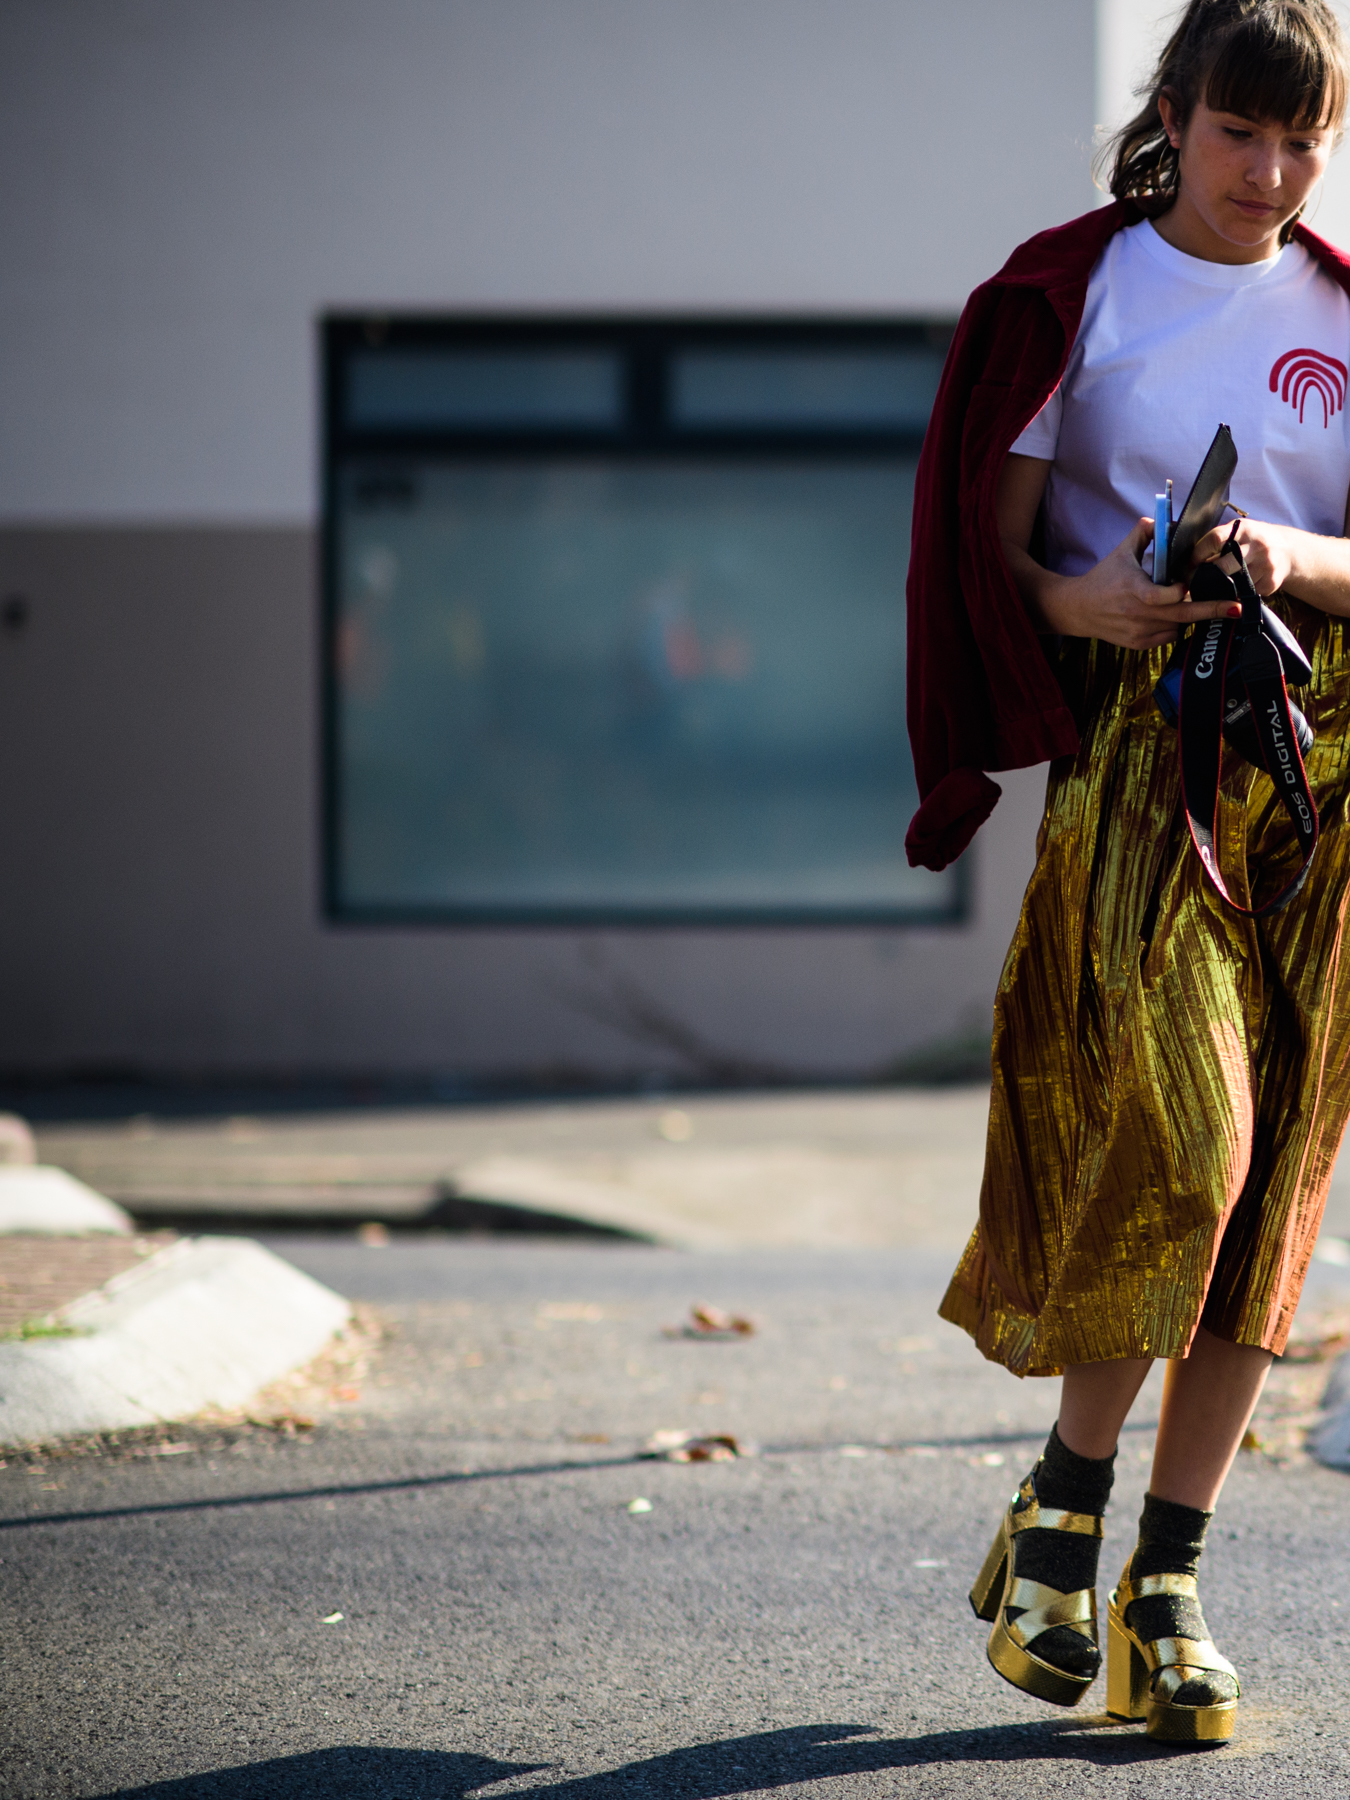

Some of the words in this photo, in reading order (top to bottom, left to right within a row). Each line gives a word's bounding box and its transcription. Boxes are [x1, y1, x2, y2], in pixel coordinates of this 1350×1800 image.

[1195, 619, 1223, 679] Canon
[1267, 700, 1296, 784] DIGITAL
[1291, 792, 1312, 834] EOS
